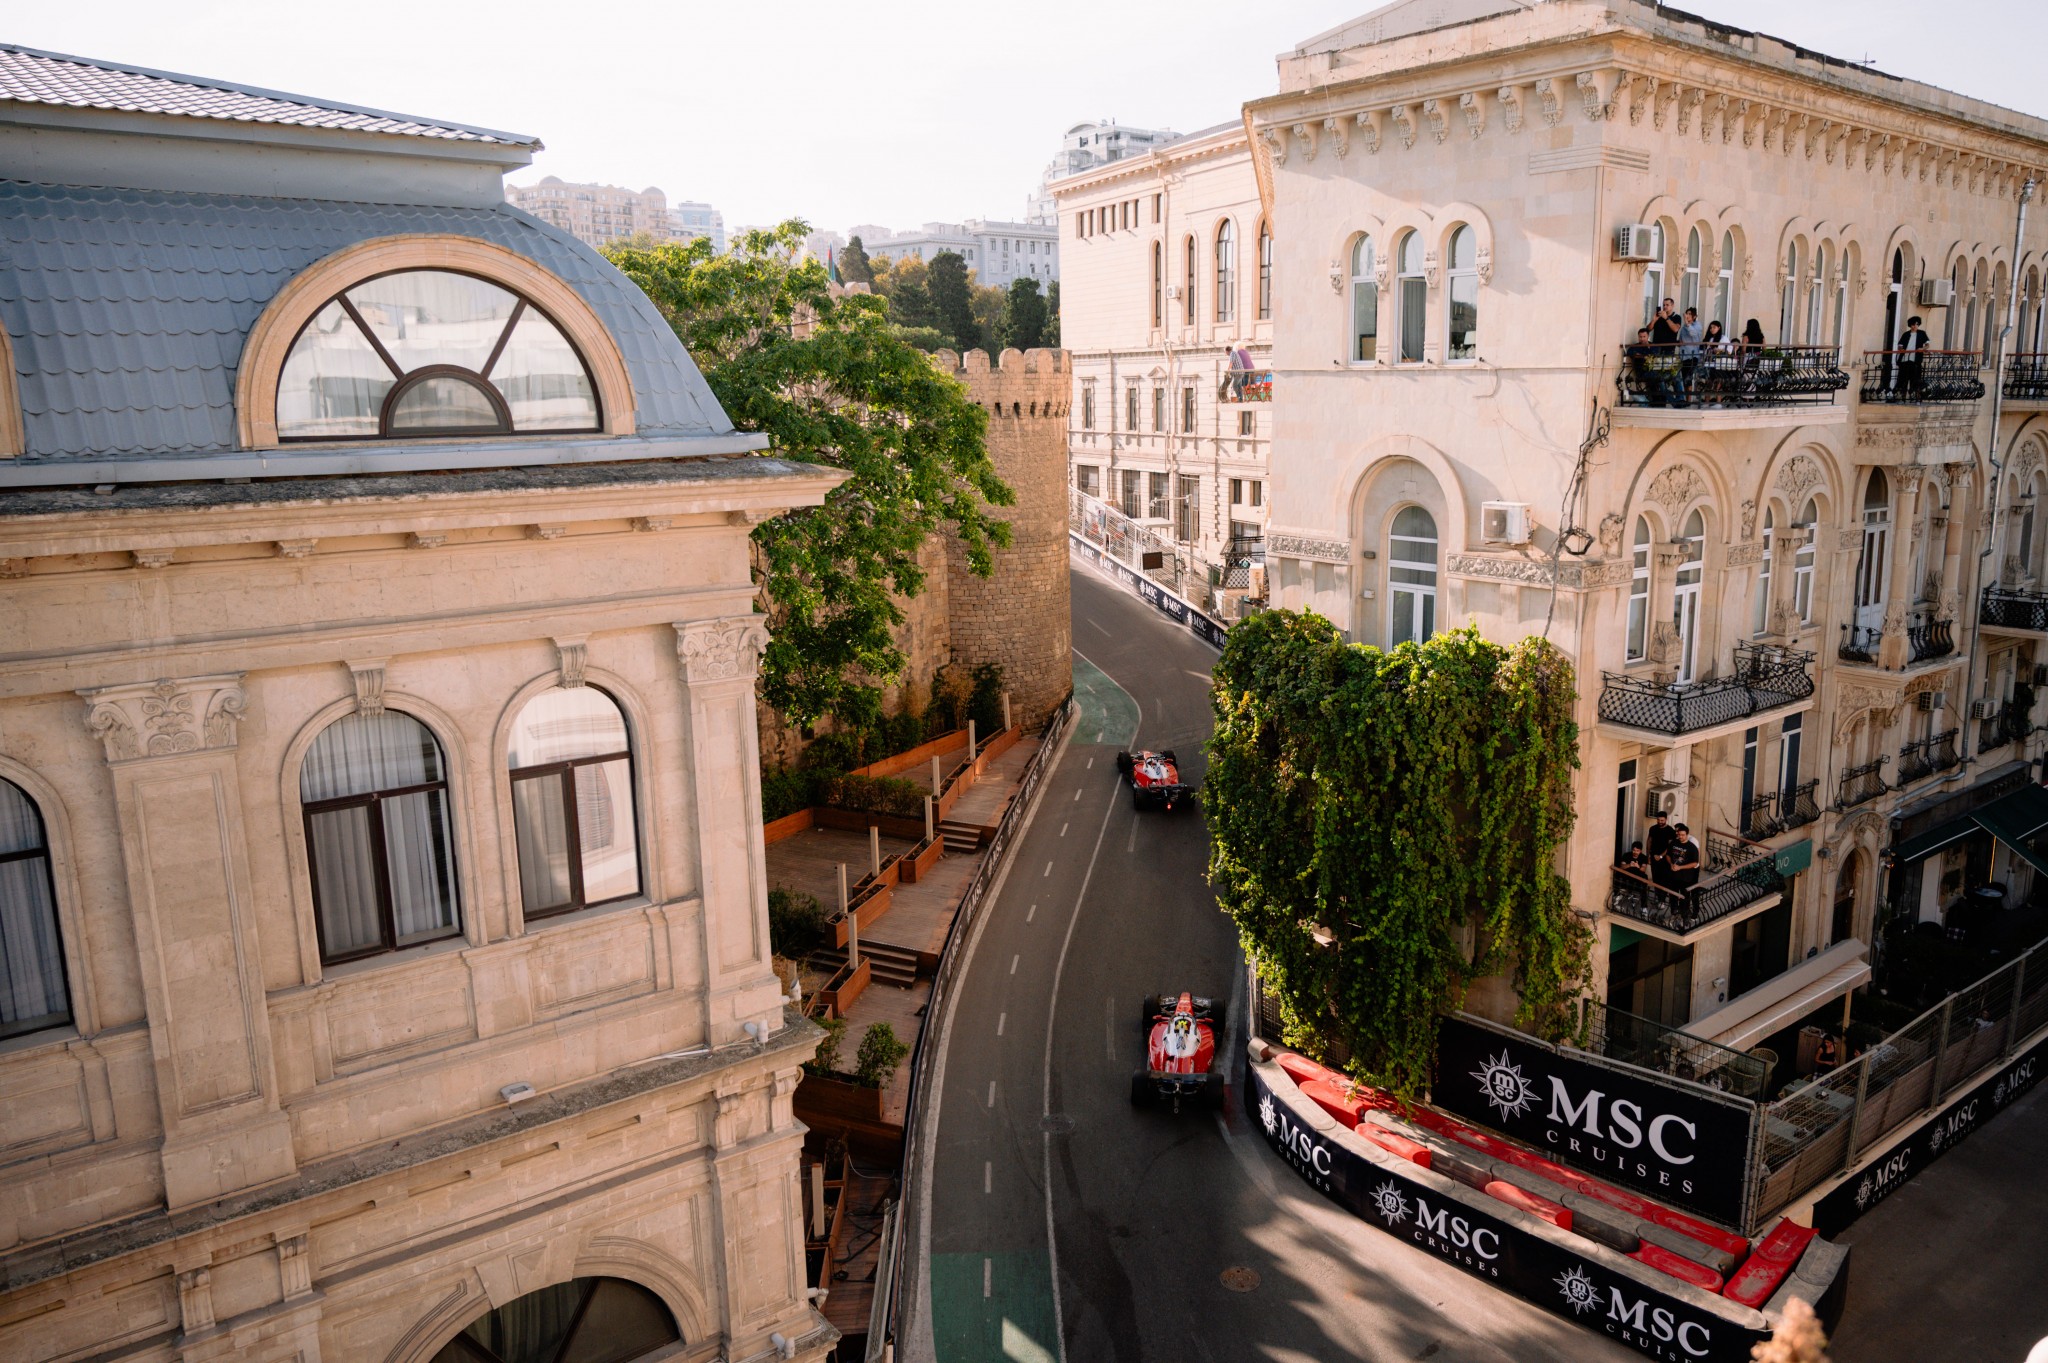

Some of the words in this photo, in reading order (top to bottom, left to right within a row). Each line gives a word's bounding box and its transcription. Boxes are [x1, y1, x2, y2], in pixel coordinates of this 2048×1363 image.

[1145, 583, 1158, 599] MSC
[1169, 598, 1182, 614] MSC
[1193, 614, 1207, 631] MSC
[2007, 1057, 2035, 1093] MSC
[1547, 1074, 1696, 1165] MSC
[1946, 1098, 1978, 1138] MSC
[1279, 1113, 1331, 1176] MSC
[1546, 1130, 1693, 1194] CRUISES
[1278, 1144, 1330, 1192] CRUISES
[1874, 1147, 1911, 1192] MSC
[1415, 1197, 1499, 1260] MSC
[1414, 1231, 1498, 1277] CRUISES
[1606, 1286, 1710, 1356] MSC
